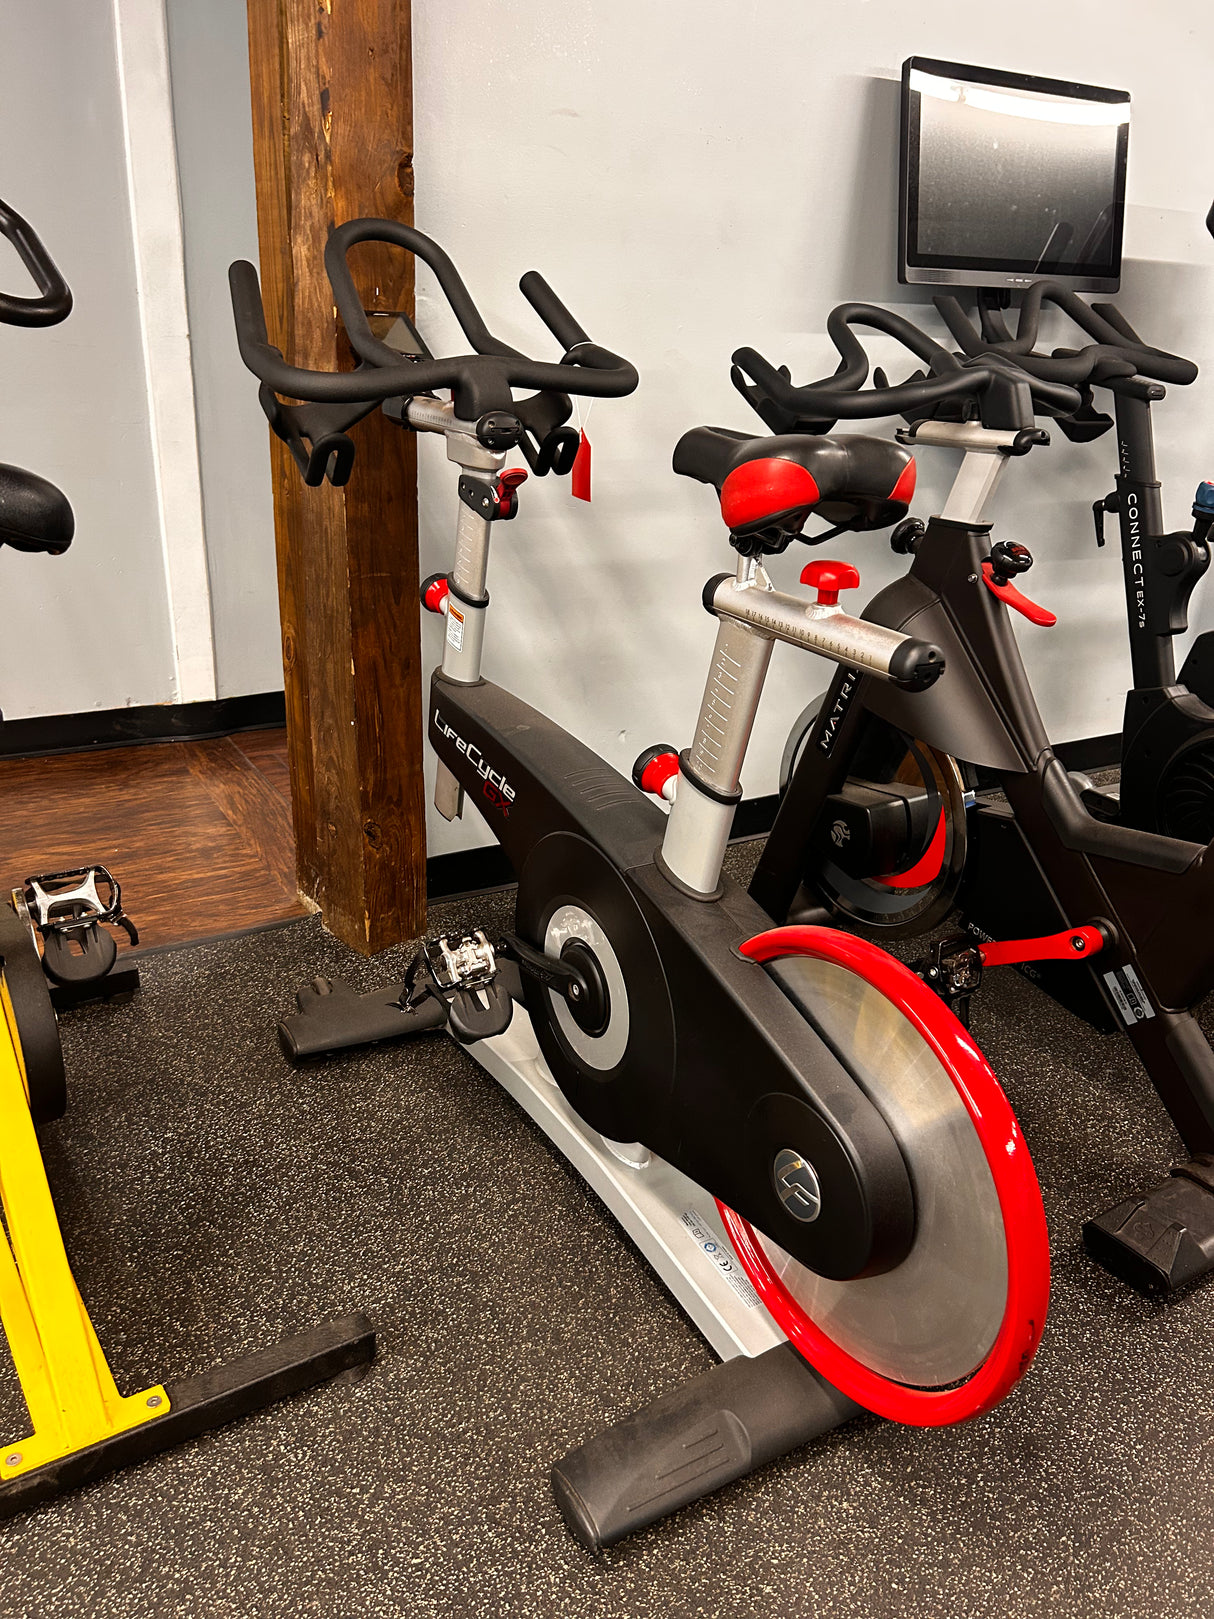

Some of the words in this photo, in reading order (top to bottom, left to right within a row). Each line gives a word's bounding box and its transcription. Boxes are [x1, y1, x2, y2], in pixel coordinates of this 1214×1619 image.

[1127, 493, 1145, 587] CONNECT
[820, 669, 859, 749] MATRI
[483, 780, 512, 817] GX
[967, 922, 997, 944] POWE
